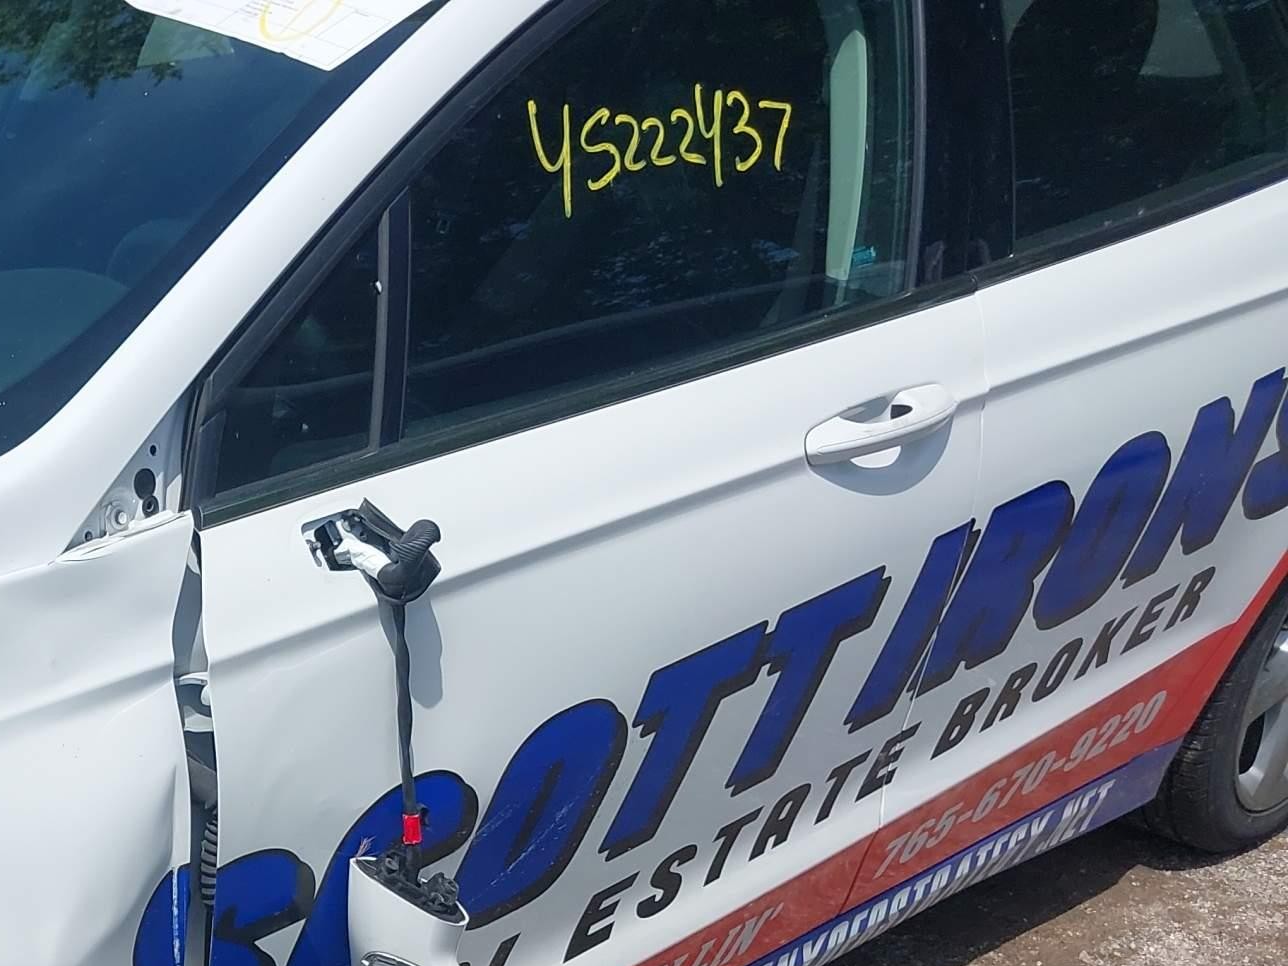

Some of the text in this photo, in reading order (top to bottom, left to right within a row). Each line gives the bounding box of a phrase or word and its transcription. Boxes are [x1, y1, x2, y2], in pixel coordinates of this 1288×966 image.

[527, 83, 793, 218] 45222437
[564, 721, 921, 964] ESTATE
[931, 567, 1216, 760] BROKER
[873, 691, 1168, 881] 765-670-9220
